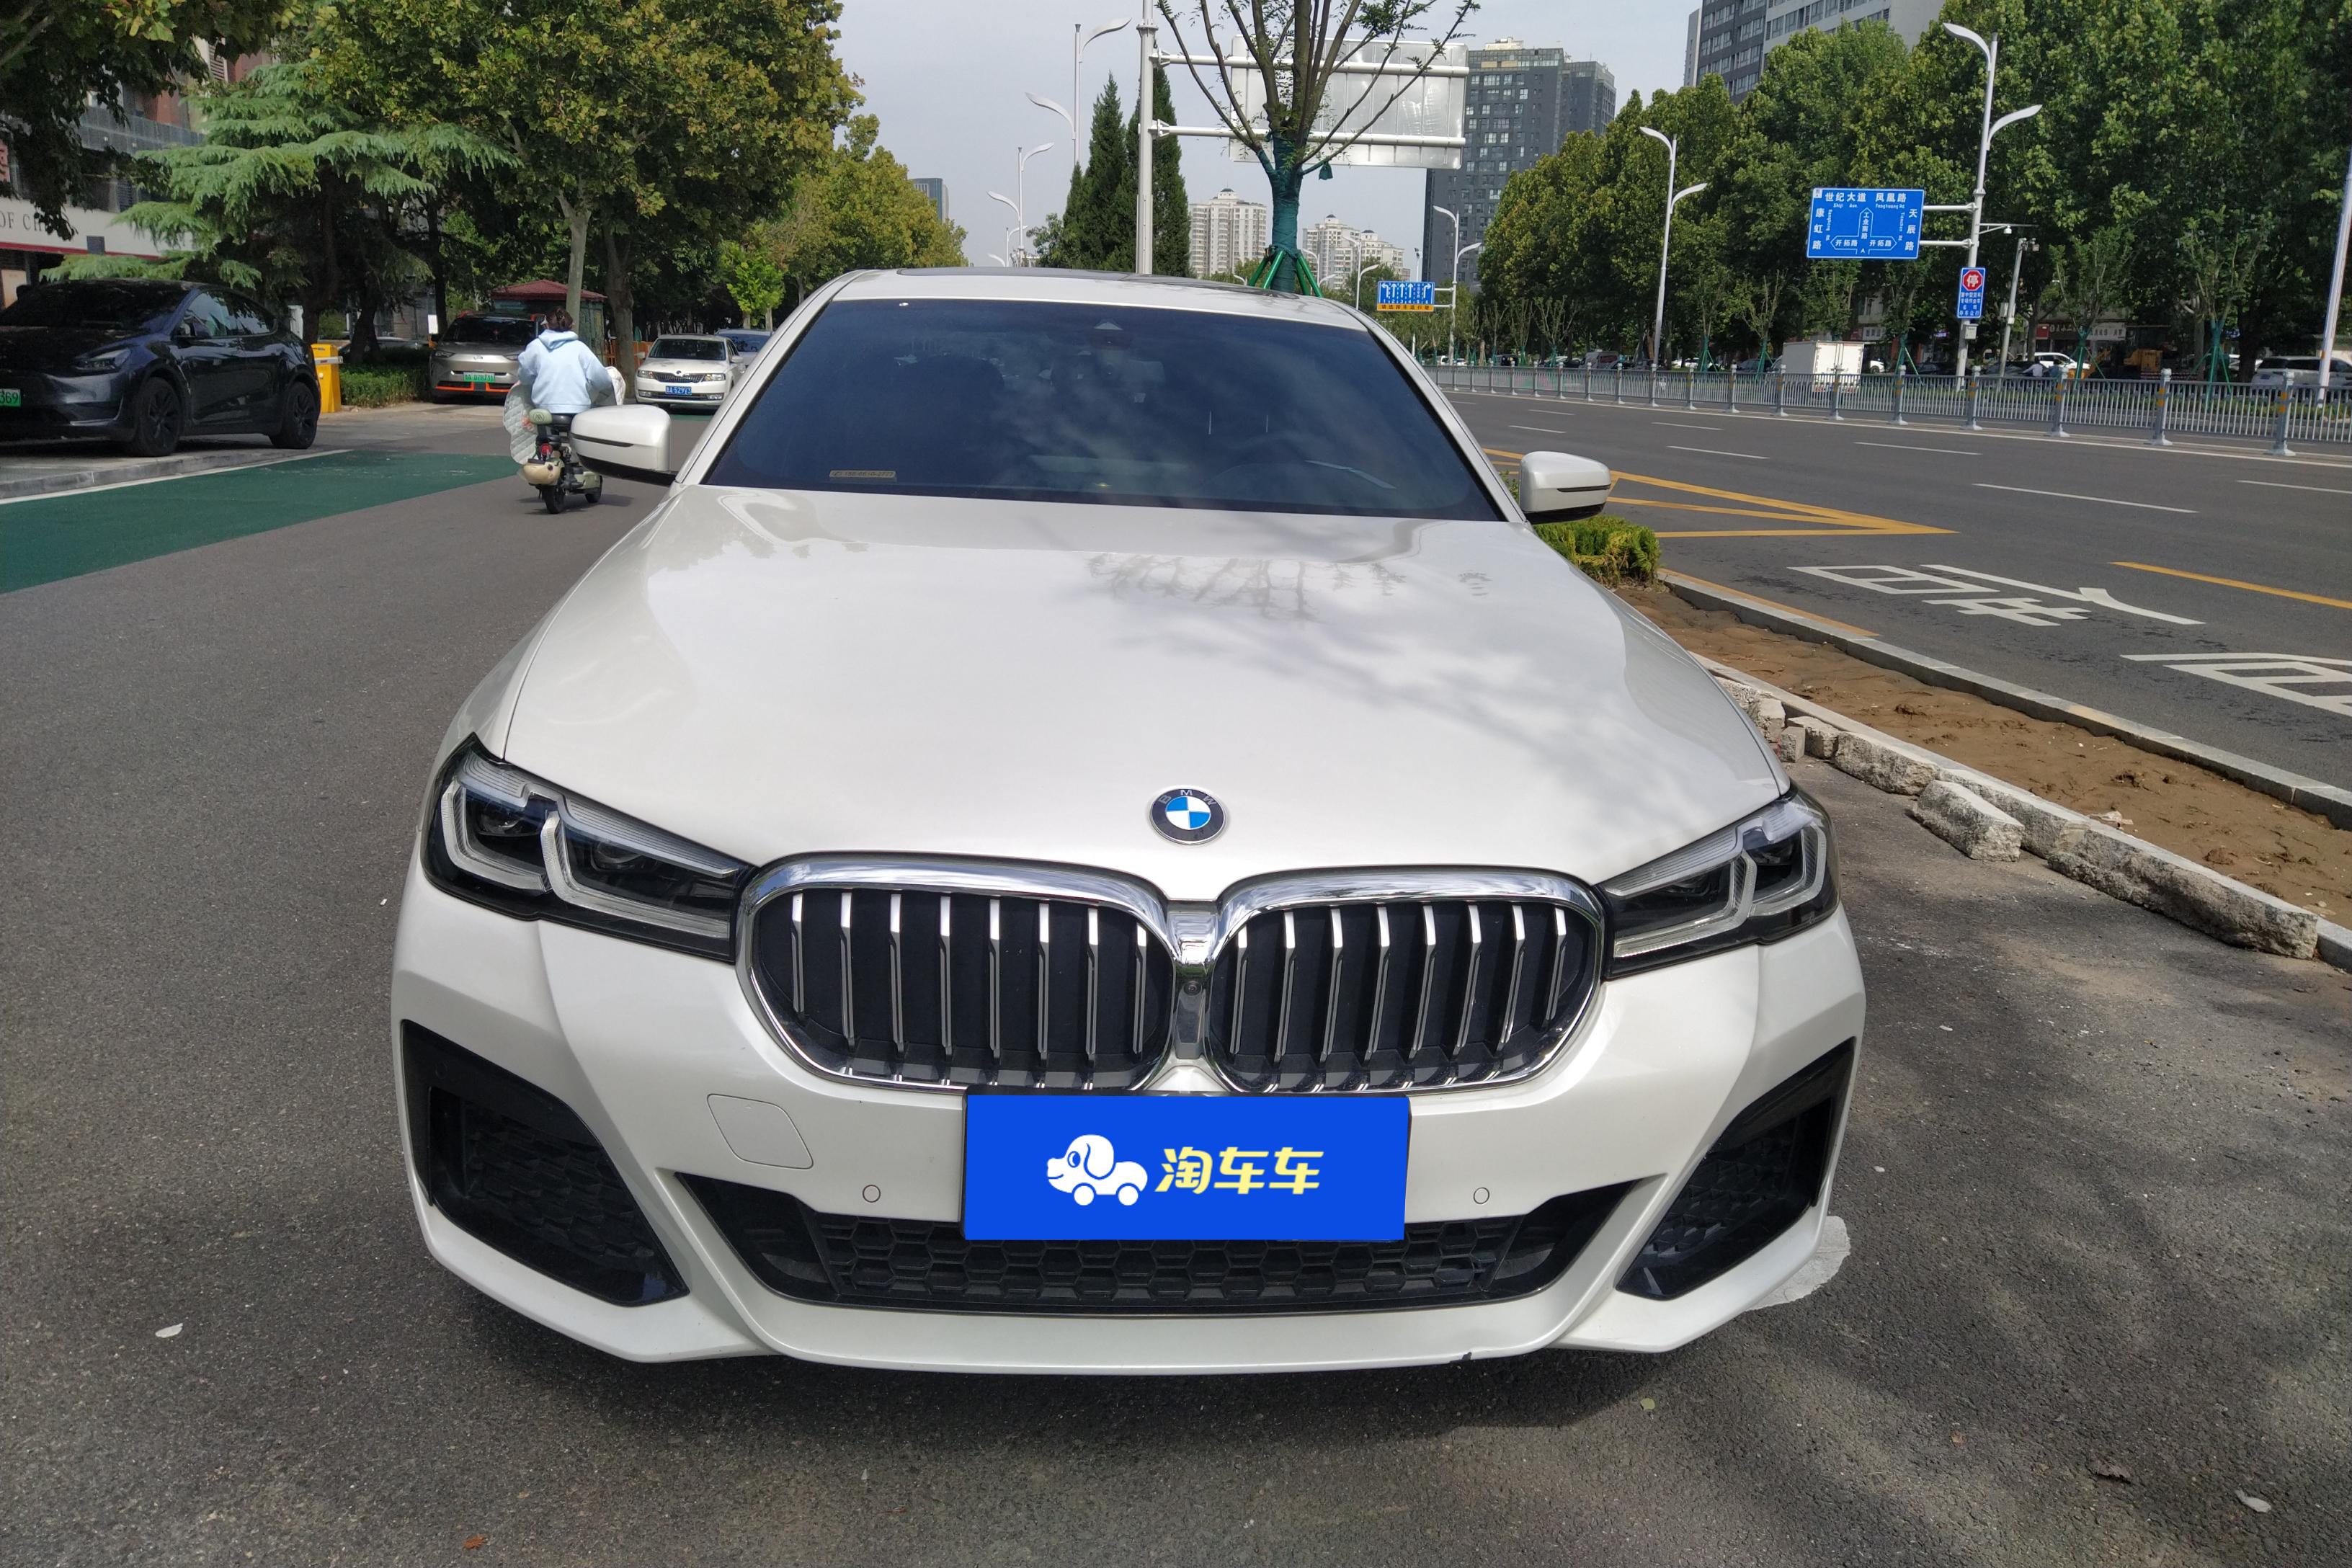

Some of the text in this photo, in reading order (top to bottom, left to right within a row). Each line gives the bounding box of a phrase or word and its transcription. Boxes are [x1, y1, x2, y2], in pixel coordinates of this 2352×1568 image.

[1825, 192, 1866, 202] 世纪大道
[1875, 192, 1907, 202] 凤凰路
[1812, 208, 1825, 250] 康虹路
[1861, 212, 1870, 240] 工业南路
[1905, 208, 1918, 251] 天辰路
[1966, 275, 1979, 287] 停
[1157, 789, 1217, 806] BMW
